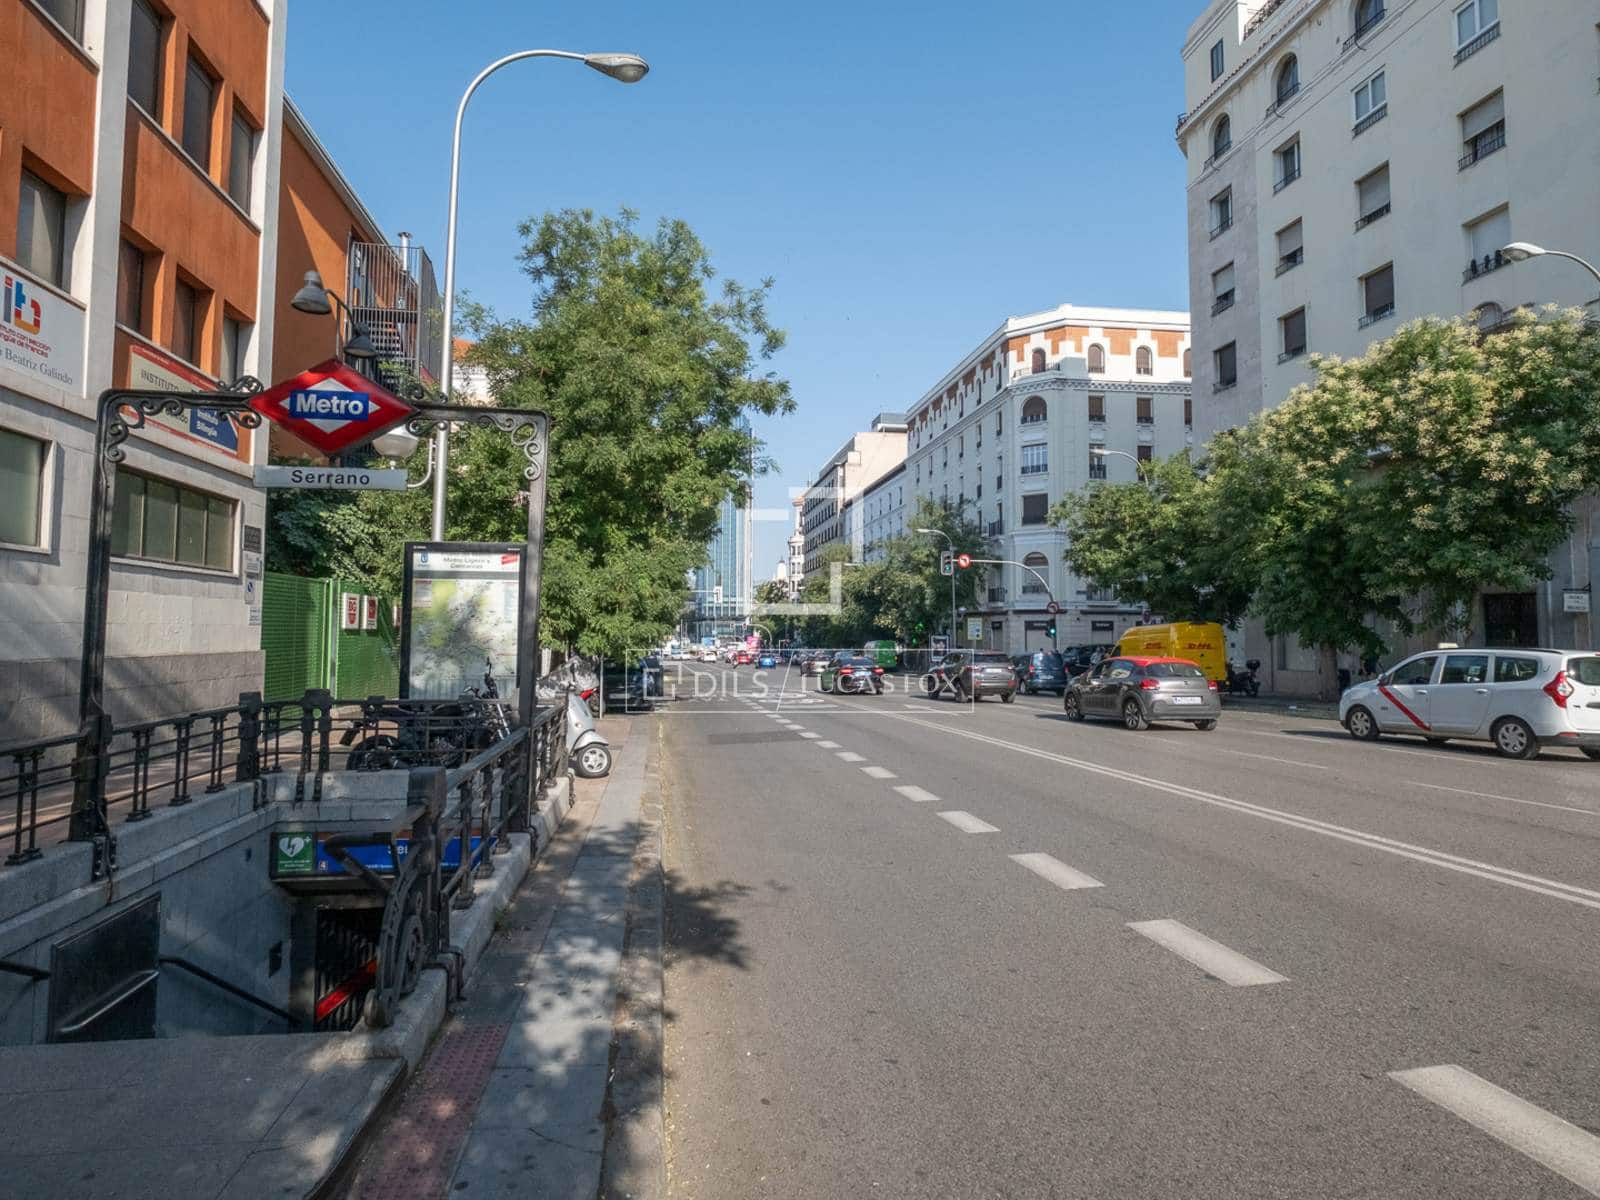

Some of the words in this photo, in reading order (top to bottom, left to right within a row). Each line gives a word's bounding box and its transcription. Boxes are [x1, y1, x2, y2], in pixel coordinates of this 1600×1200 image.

[5, 348, 38, 370] Beatriz
[40, 361, 73, 385] Galindo
[296, 392, 364, 415] Metro
[291, 469, 370, 486] Serrano
